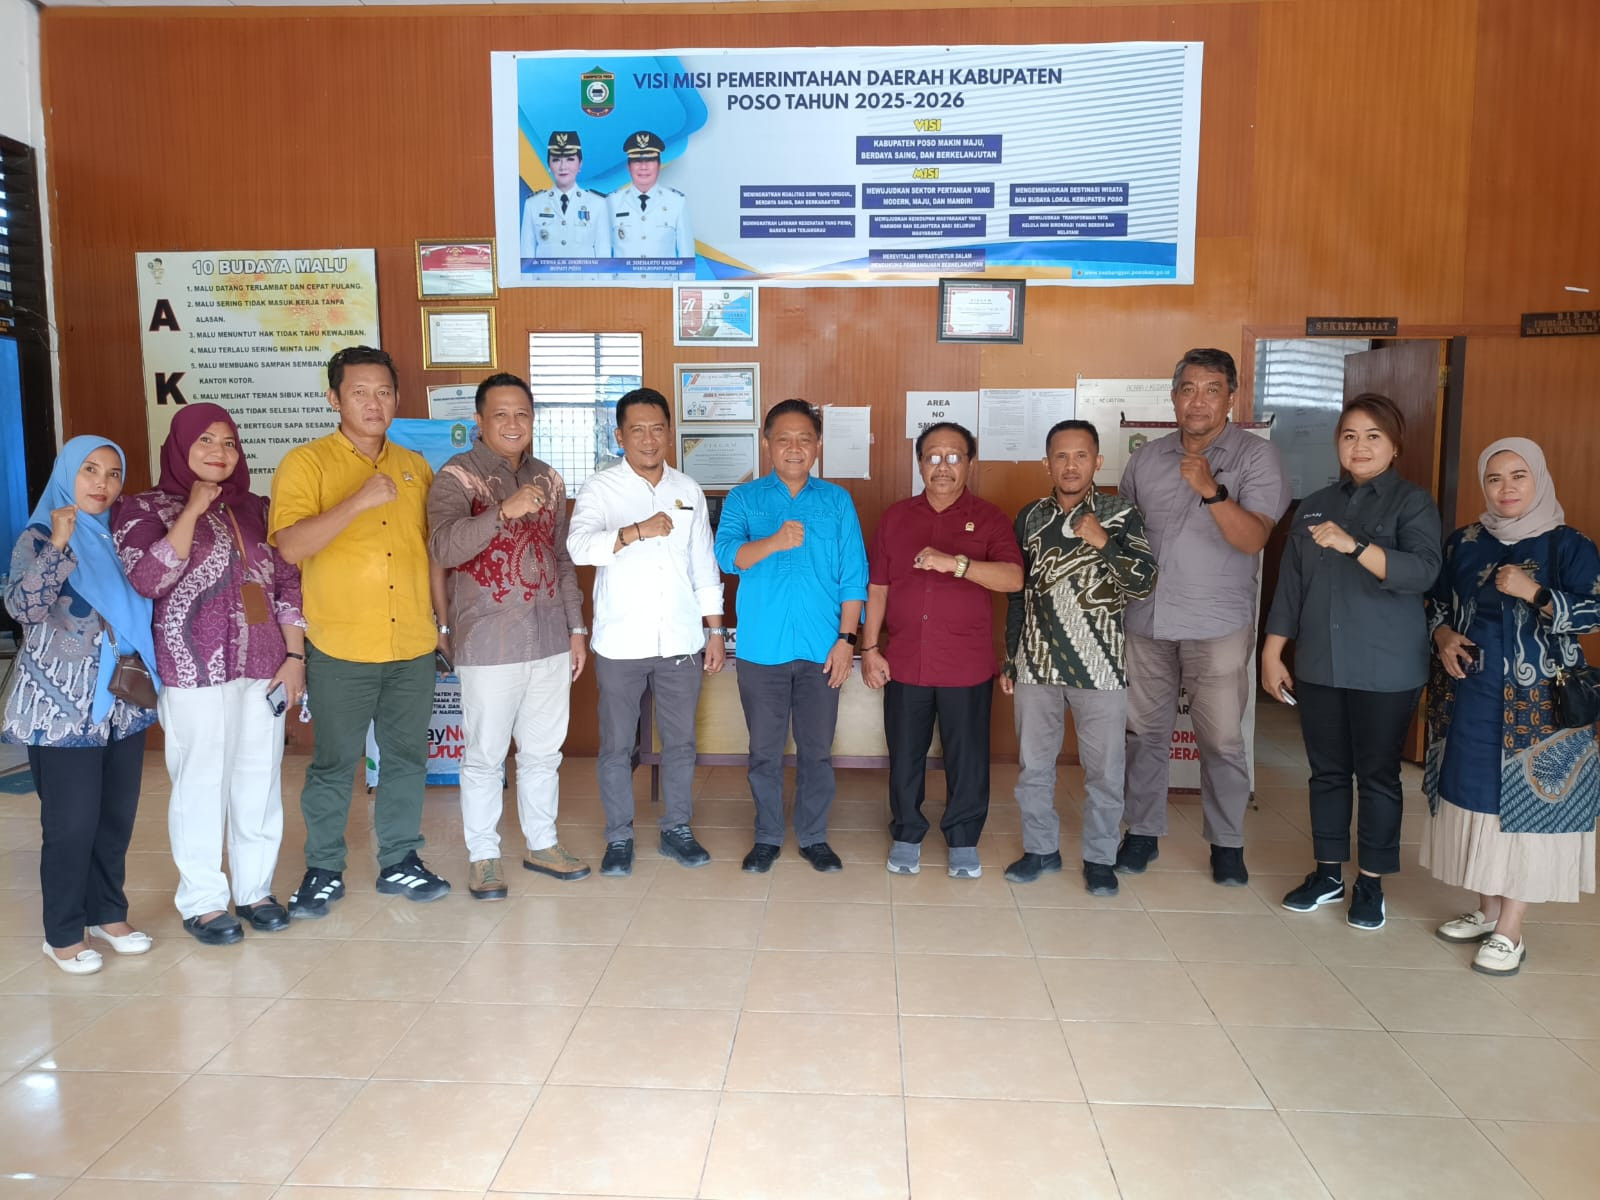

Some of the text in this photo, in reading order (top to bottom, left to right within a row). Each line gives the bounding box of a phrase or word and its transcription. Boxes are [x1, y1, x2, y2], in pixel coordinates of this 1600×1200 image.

[633, 68, 1062, 88] VISI MISI PEMERINTAHAN DAERAH KABUPATEN
[728, 92, 964, 110] POSO TAHUN 2025-2026
[913, 119, 942, 132] VISI
[962, 138, 984, 148] MAJU,
[894, 152, 918, 160] SAING,
[936, 151, 997, 159] BERKELANJUTAN
[912, 168, 940, 180] MISI
[192, 258, 347, 275] 10 BUDAYA MALU
[148, 300, 180, 332] A
[1316, 322, 1389, 331] SEKRETARIAT
[154, 372, 188, 404] K
